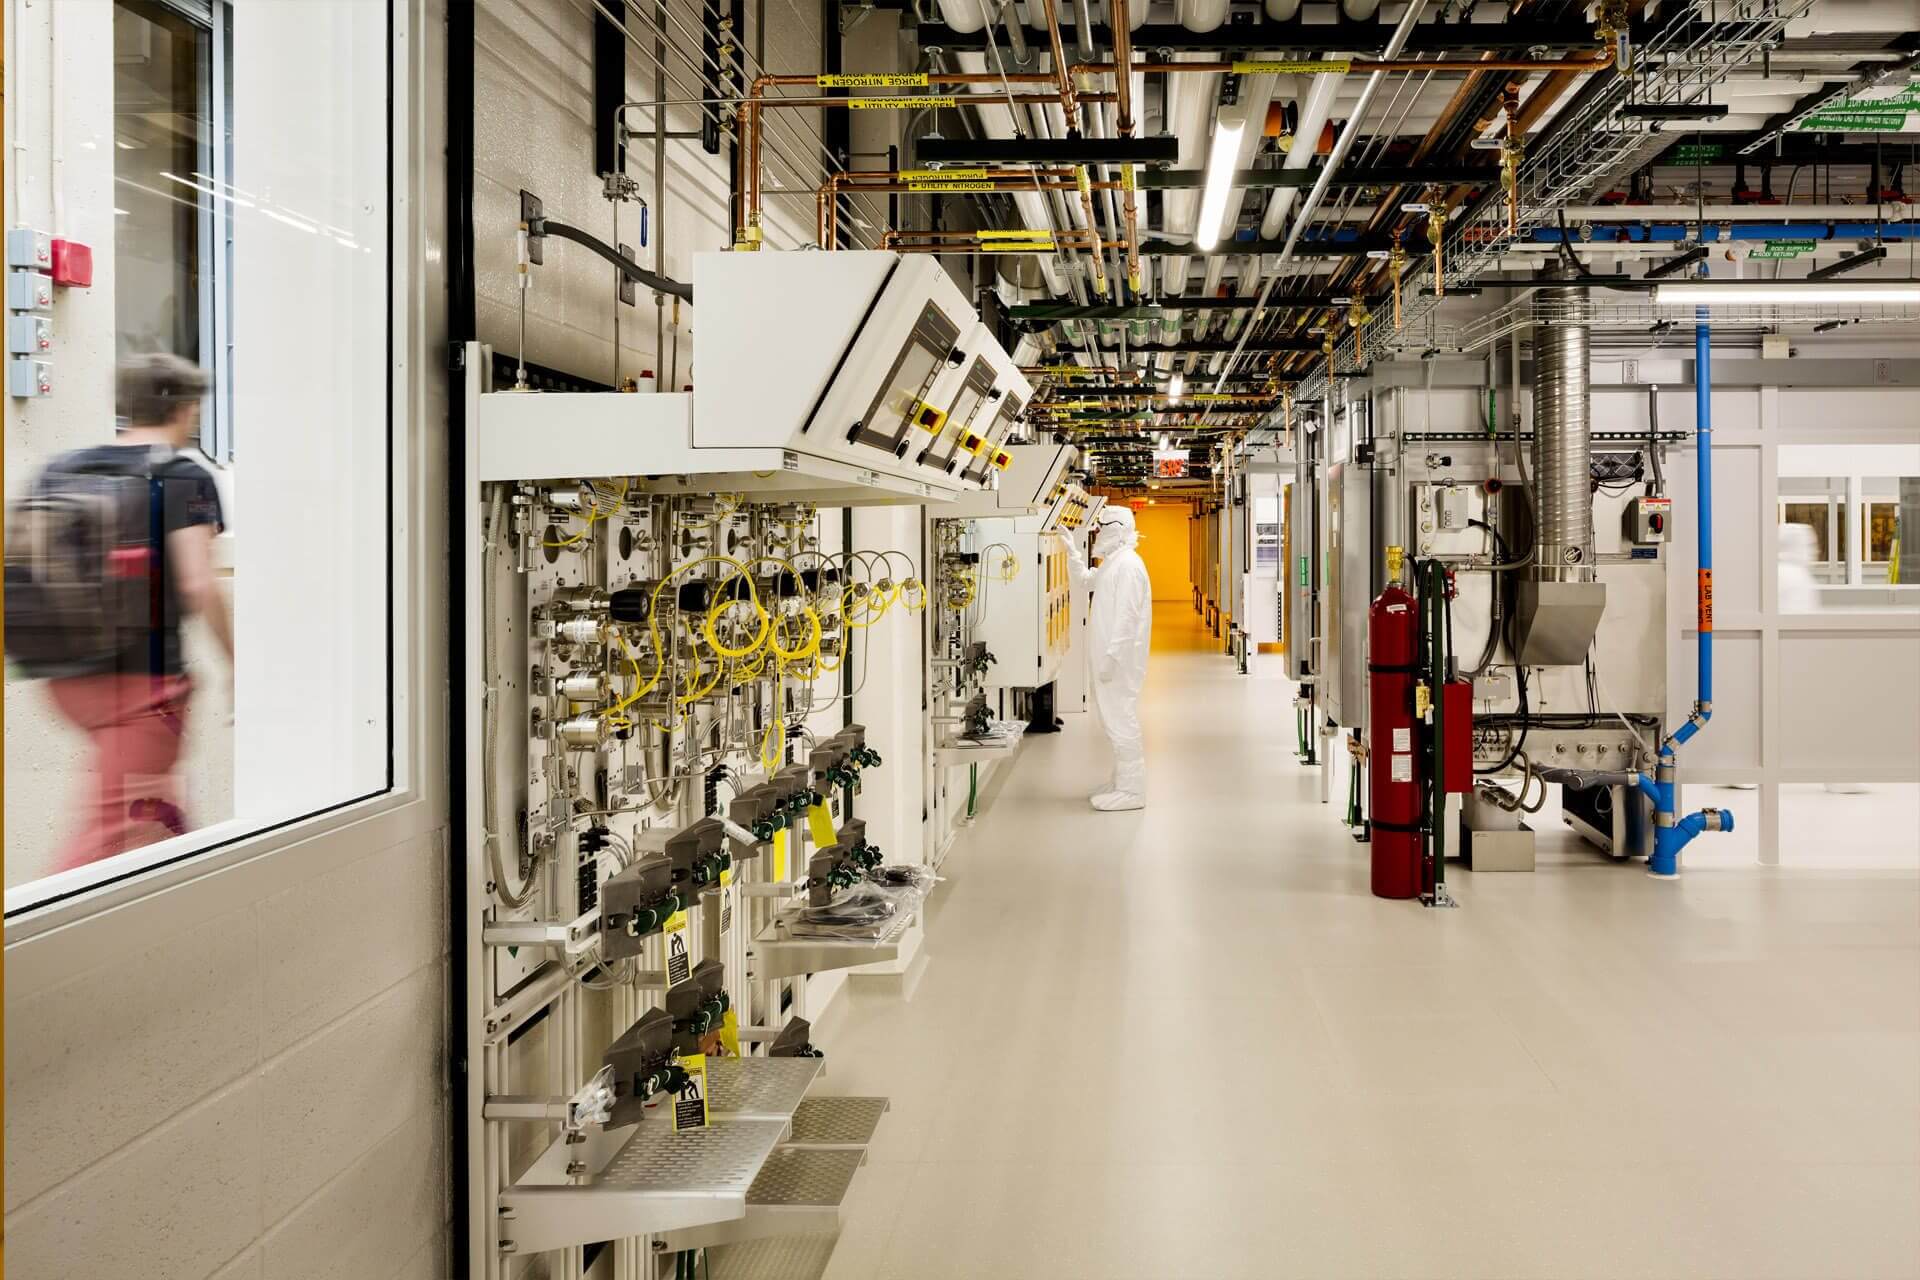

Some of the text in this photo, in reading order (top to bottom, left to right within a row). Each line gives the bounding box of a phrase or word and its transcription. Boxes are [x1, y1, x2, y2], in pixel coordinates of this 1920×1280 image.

[832, 78, 922, 86] PURGE NITROGEN
[1704, 584, 1713, 623] LAB VENT
